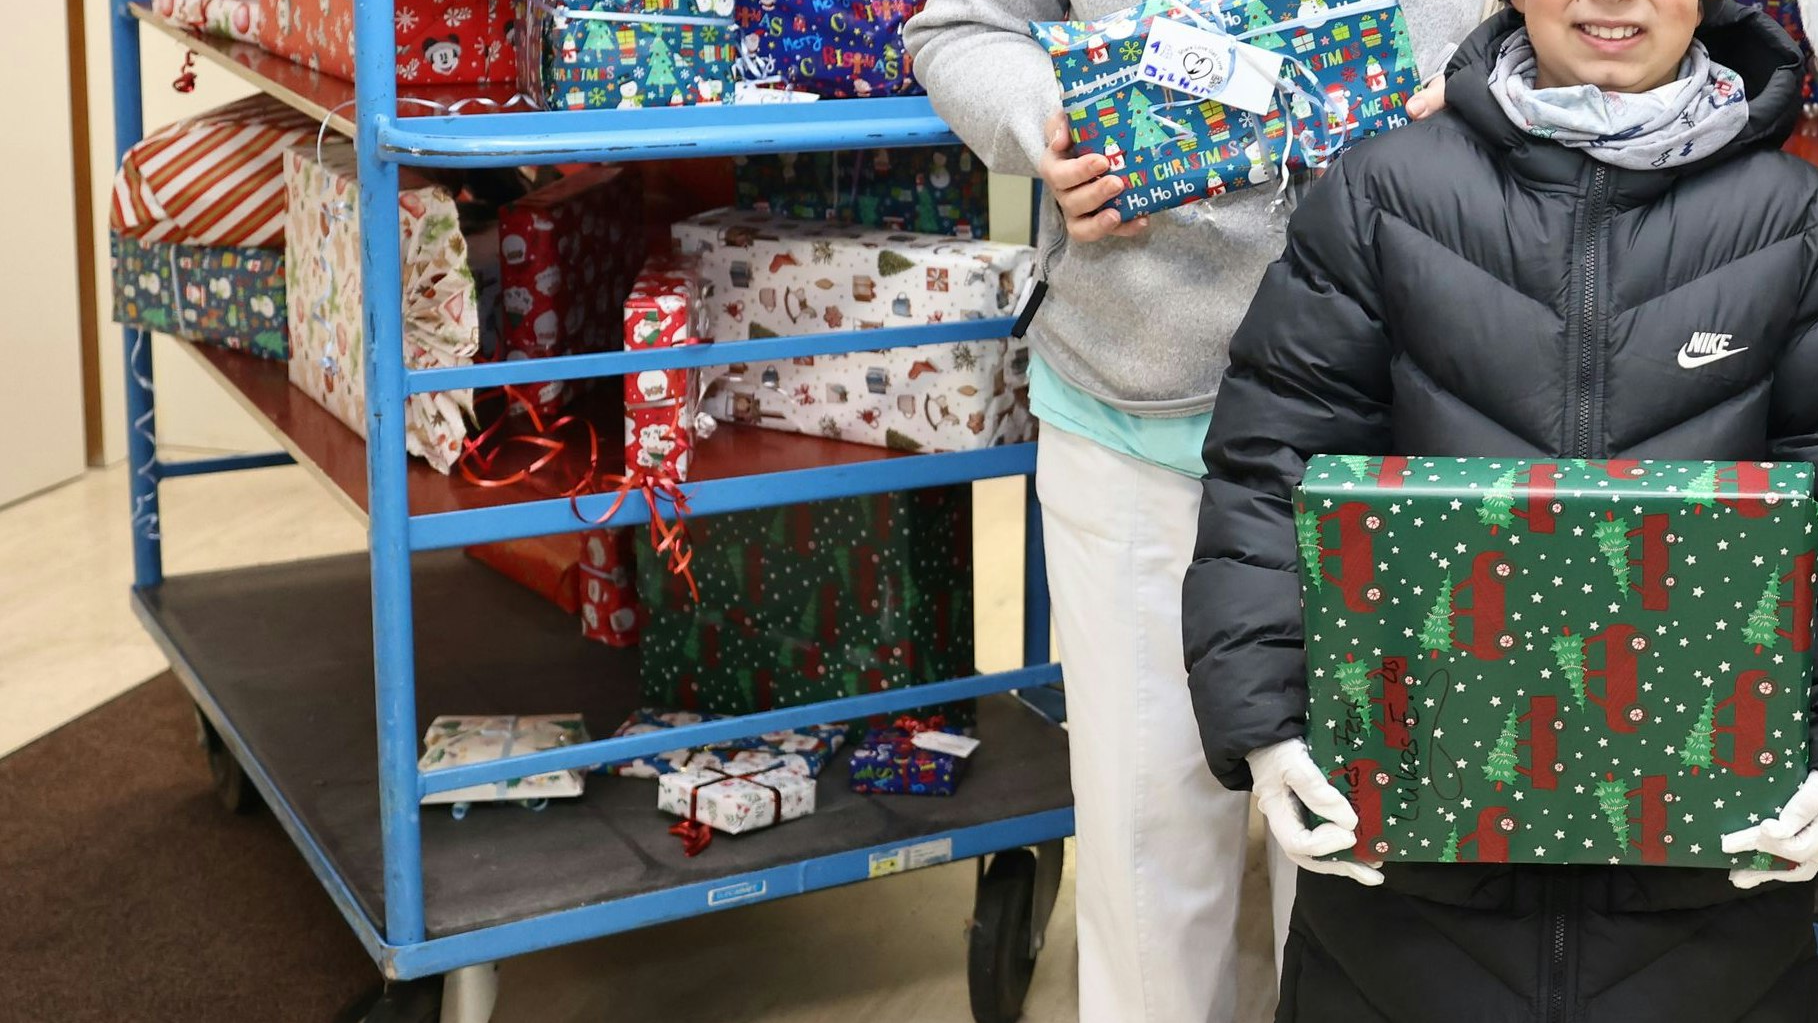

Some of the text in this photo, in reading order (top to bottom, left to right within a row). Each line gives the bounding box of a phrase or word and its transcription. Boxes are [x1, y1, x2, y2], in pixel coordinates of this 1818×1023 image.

[782, 33, 823, 52] Merry
[1361, 91, 1409, 118] MERRY
[1387, 114, 1408, 129] Ho
[1153, 140, 1239, 182] CHRISTMAS
[1127, 180, 1195, 210] Ho Ho Ho
[1686, 331, 1733, 354] NIKE
